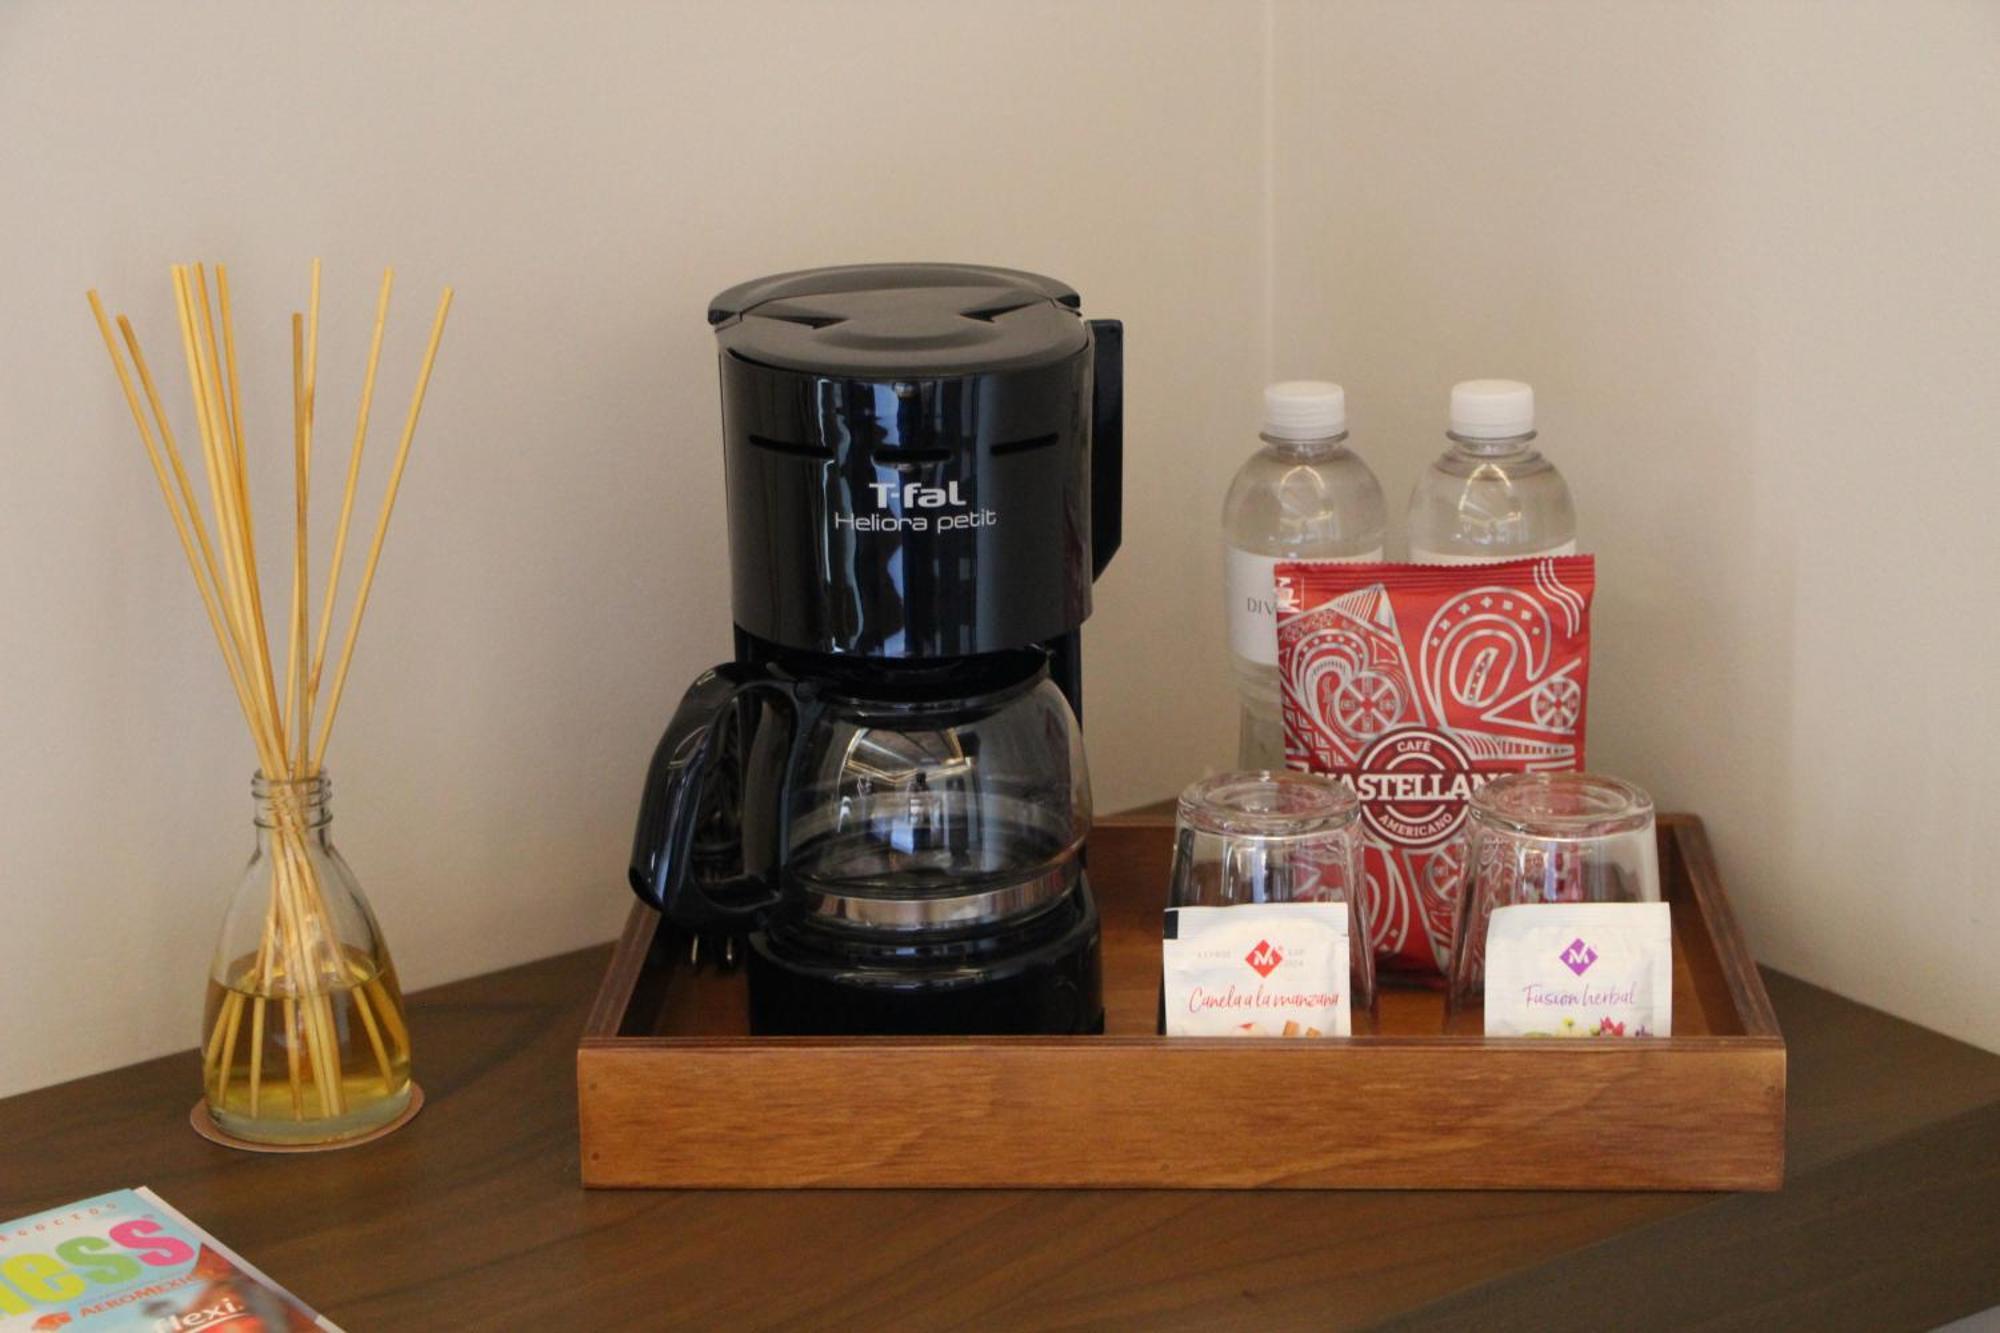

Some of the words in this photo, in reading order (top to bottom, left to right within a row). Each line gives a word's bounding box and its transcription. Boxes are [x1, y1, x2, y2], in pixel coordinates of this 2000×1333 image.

[868, 481, 968, 509] T-fal
[834, 511, 928, 533] Heliora
[937, 509, 998, 535] petit
[1396, 739, 1432, 753] CAFÉ
[1378, 812, 1454, 838] AMERICANO
[1188, 984, 1243, 1013] Canela
[1273, 993, 1340, 1010] manzana
[1582, 981, 1638, 1008] herbal
